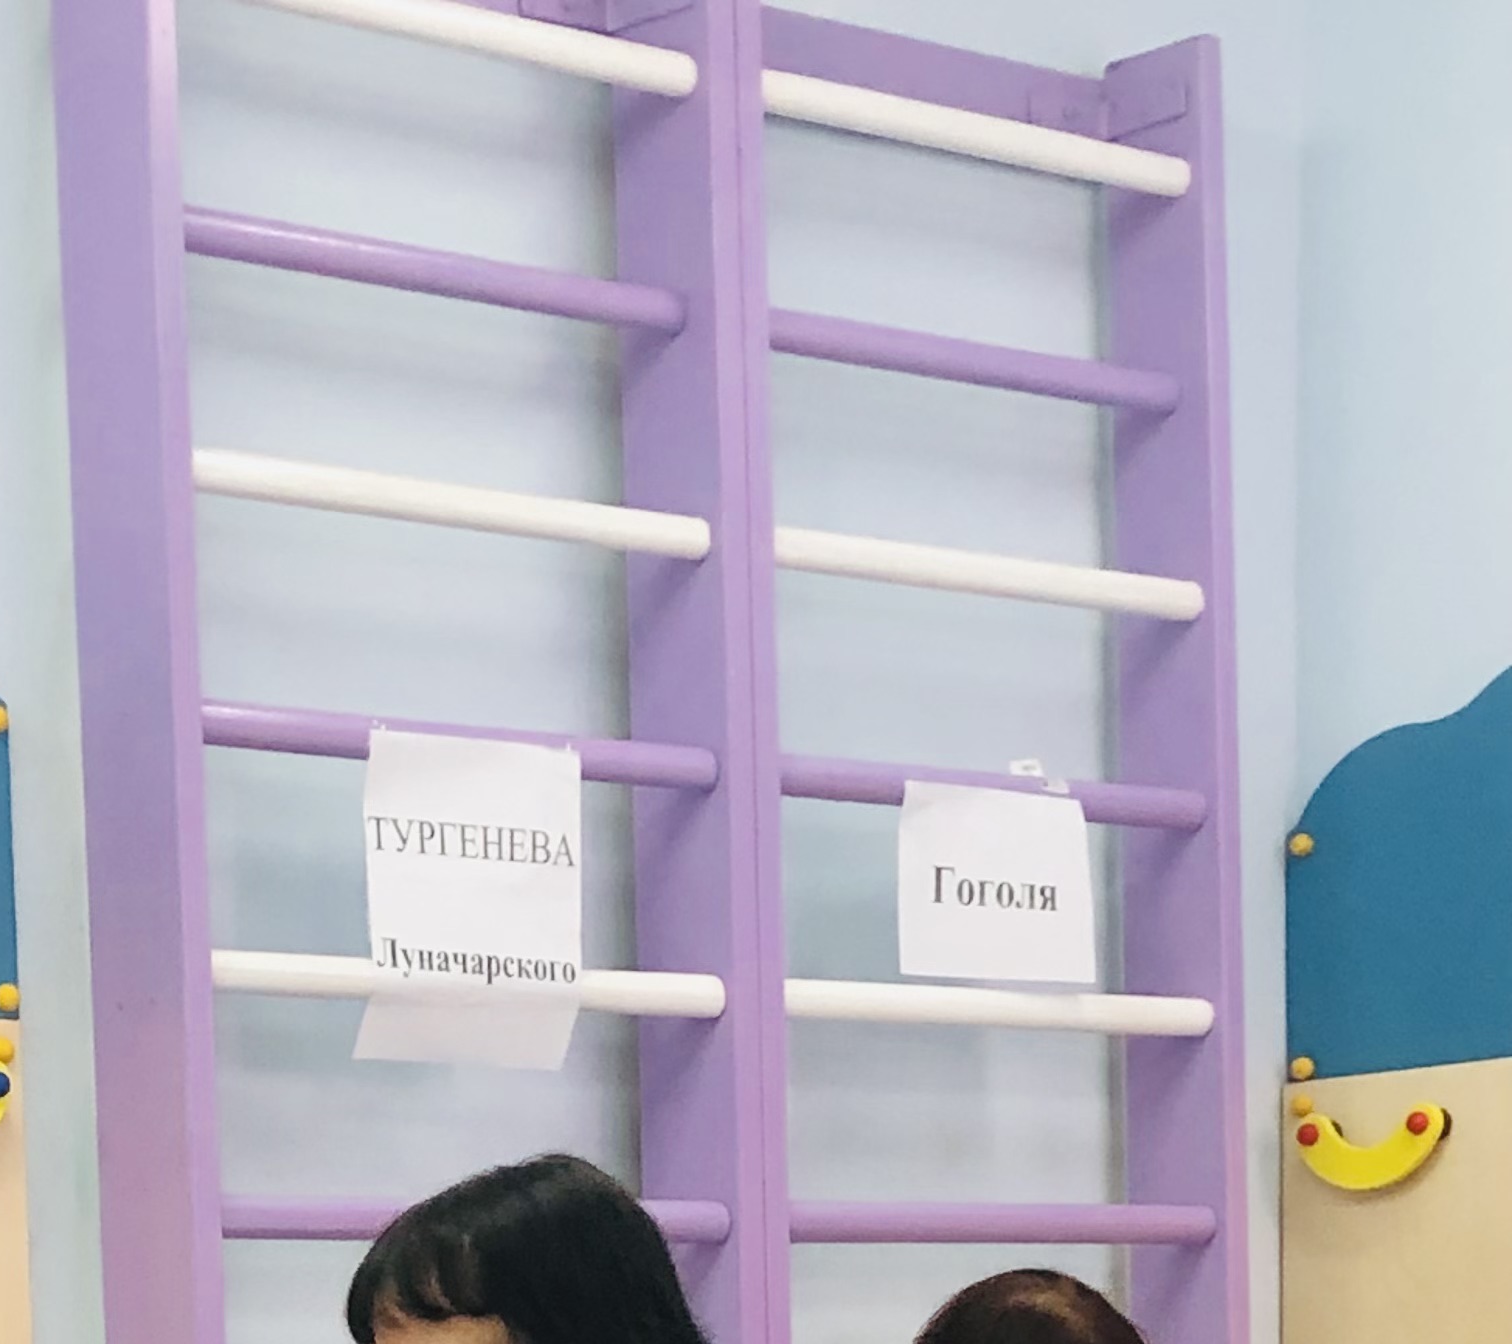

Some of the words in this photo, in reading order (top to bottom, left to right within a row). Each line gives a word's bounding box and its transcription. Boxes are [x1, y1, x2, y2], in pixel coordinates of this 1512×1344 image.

[367, 816, 576, 867] ТУРГЕНЕВА
[932, 865, 1058, 912] Гоголя
[376, 937, 577, 986] Луначарского
